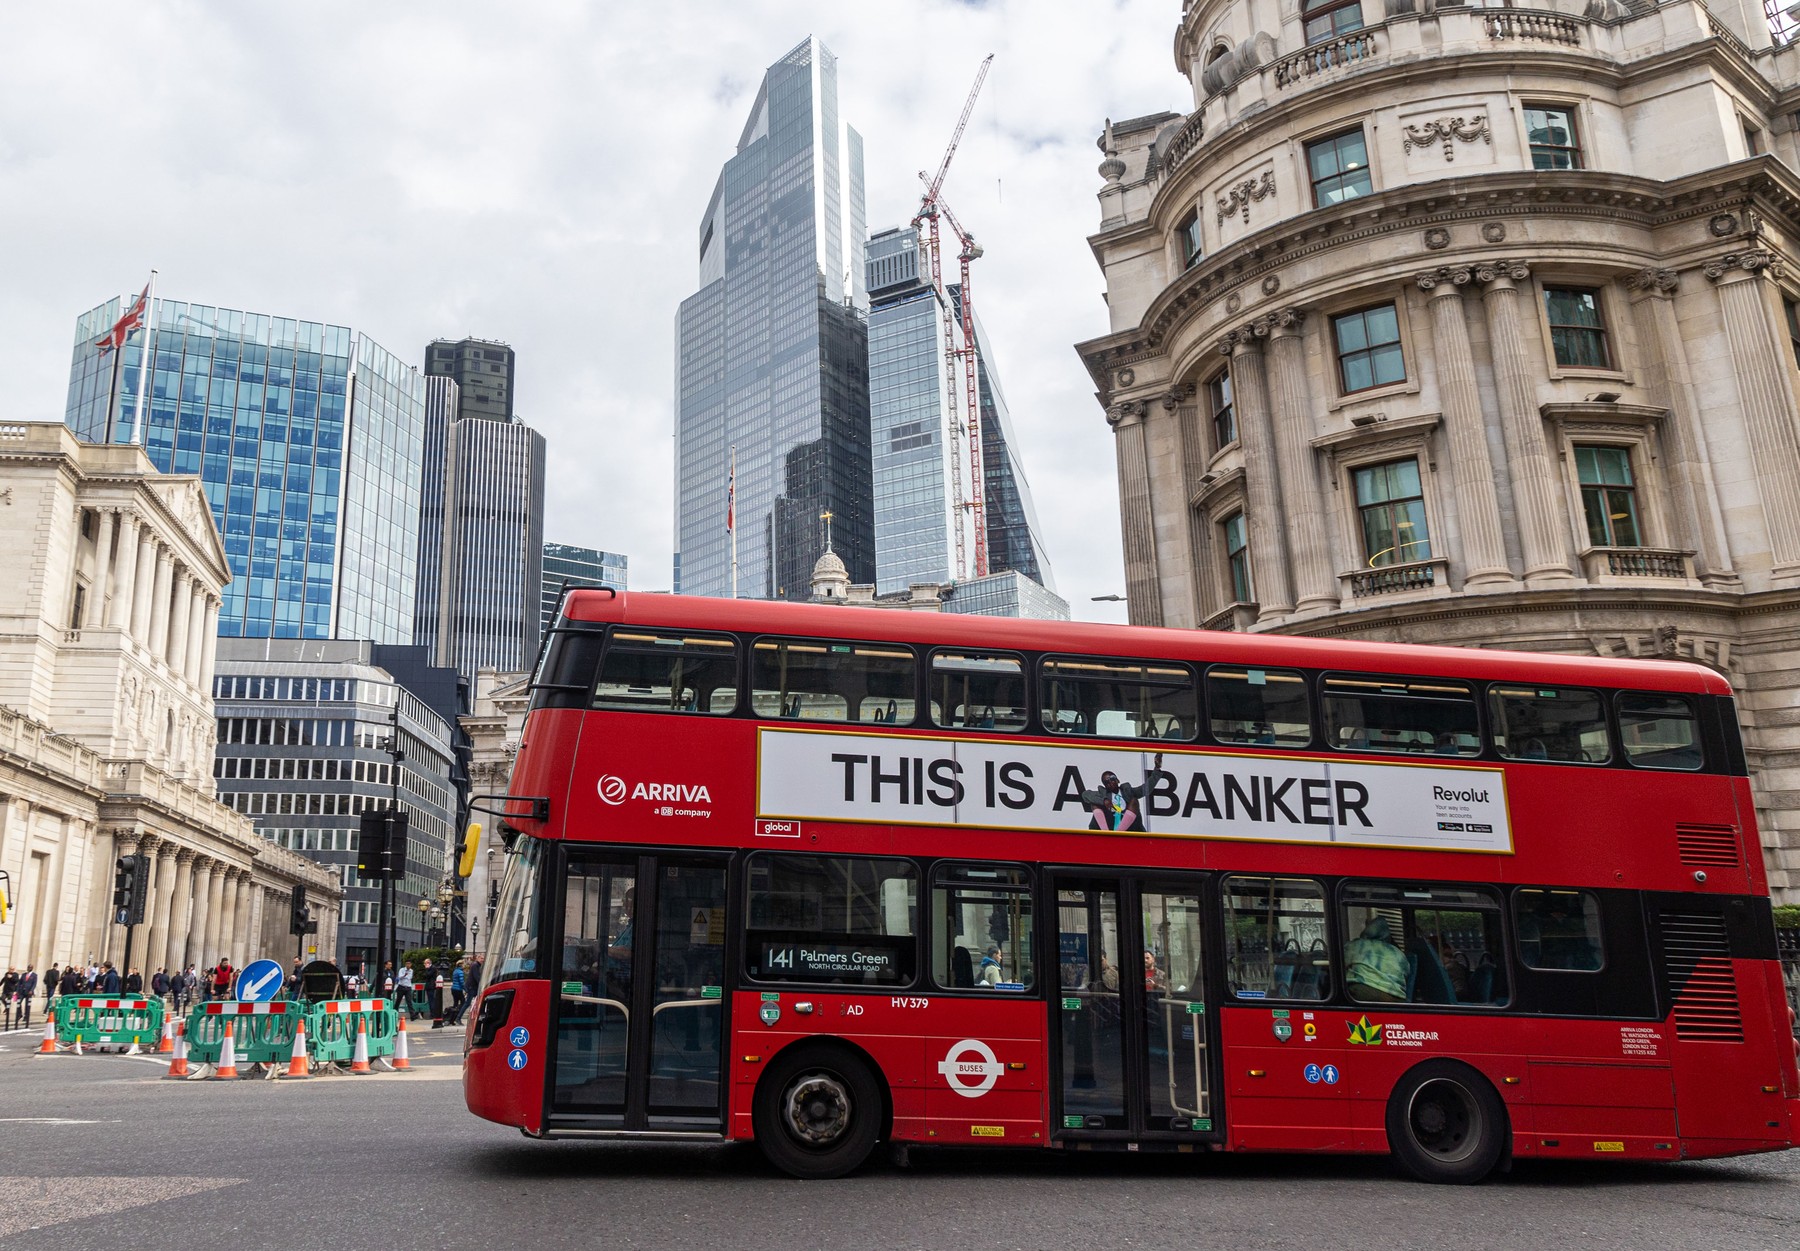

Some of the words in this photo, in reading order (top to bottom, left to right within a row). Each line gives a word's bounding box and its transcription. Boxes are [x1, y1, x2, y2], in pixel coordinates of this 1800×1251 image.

[631, 782, 712, 803] ARRIVA
[831, 753, 965, 807] THIS
[984, 761, 1035, 810] IS
[1052, 765, 1093, 813] A
[1145, 770, 1374, 828] BANKER
[1433, 785, 1490, 803] Revolut
[661, 806, 673, 816] DB
[675, 808, 711, 818] company
[764, 822, 791, 834] global
[768, 948, 793, 968] 141
[800, 949, 847, 963] Palmers
[852, 952, 889, 965] Green
[831, 963, 861, 971] CIRCULAR
[847, 1005, 864, 1015] AD
[1385, 1030, 1439, 1041] CLEANERAIR
[959, 1064, 983, 1073] BUSES
